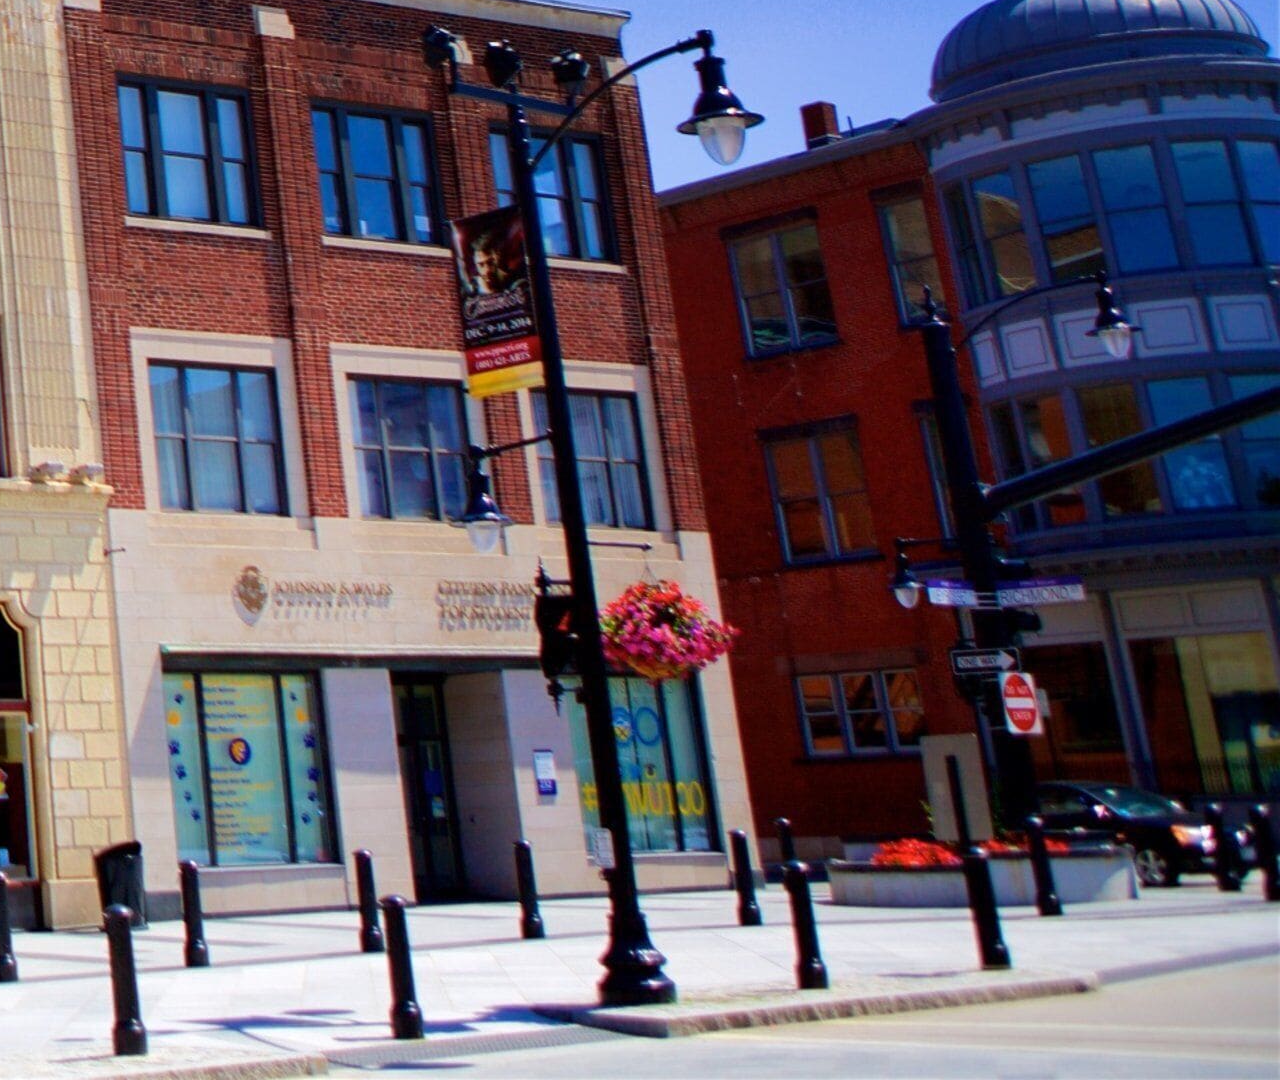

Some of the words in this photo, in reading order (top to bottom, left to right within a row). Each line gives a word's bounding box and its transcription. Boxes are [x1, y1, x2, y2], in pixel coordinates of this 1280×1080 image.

[273, 580, 337, 595] JOHNSON
[352, 582, 394, 596] WALES
[438, 578, 498, 596] CITIZENS
[1000, 586, 1069, 603] RICHMOND
[959, 656, 979, 669] ONE
[981, 654, 999, 668] WAY
[1005, 685, 1015, 695] DO
[1016, 684, 1030, 695] NOT
[1013, 711, 1032, 721] ENTER
